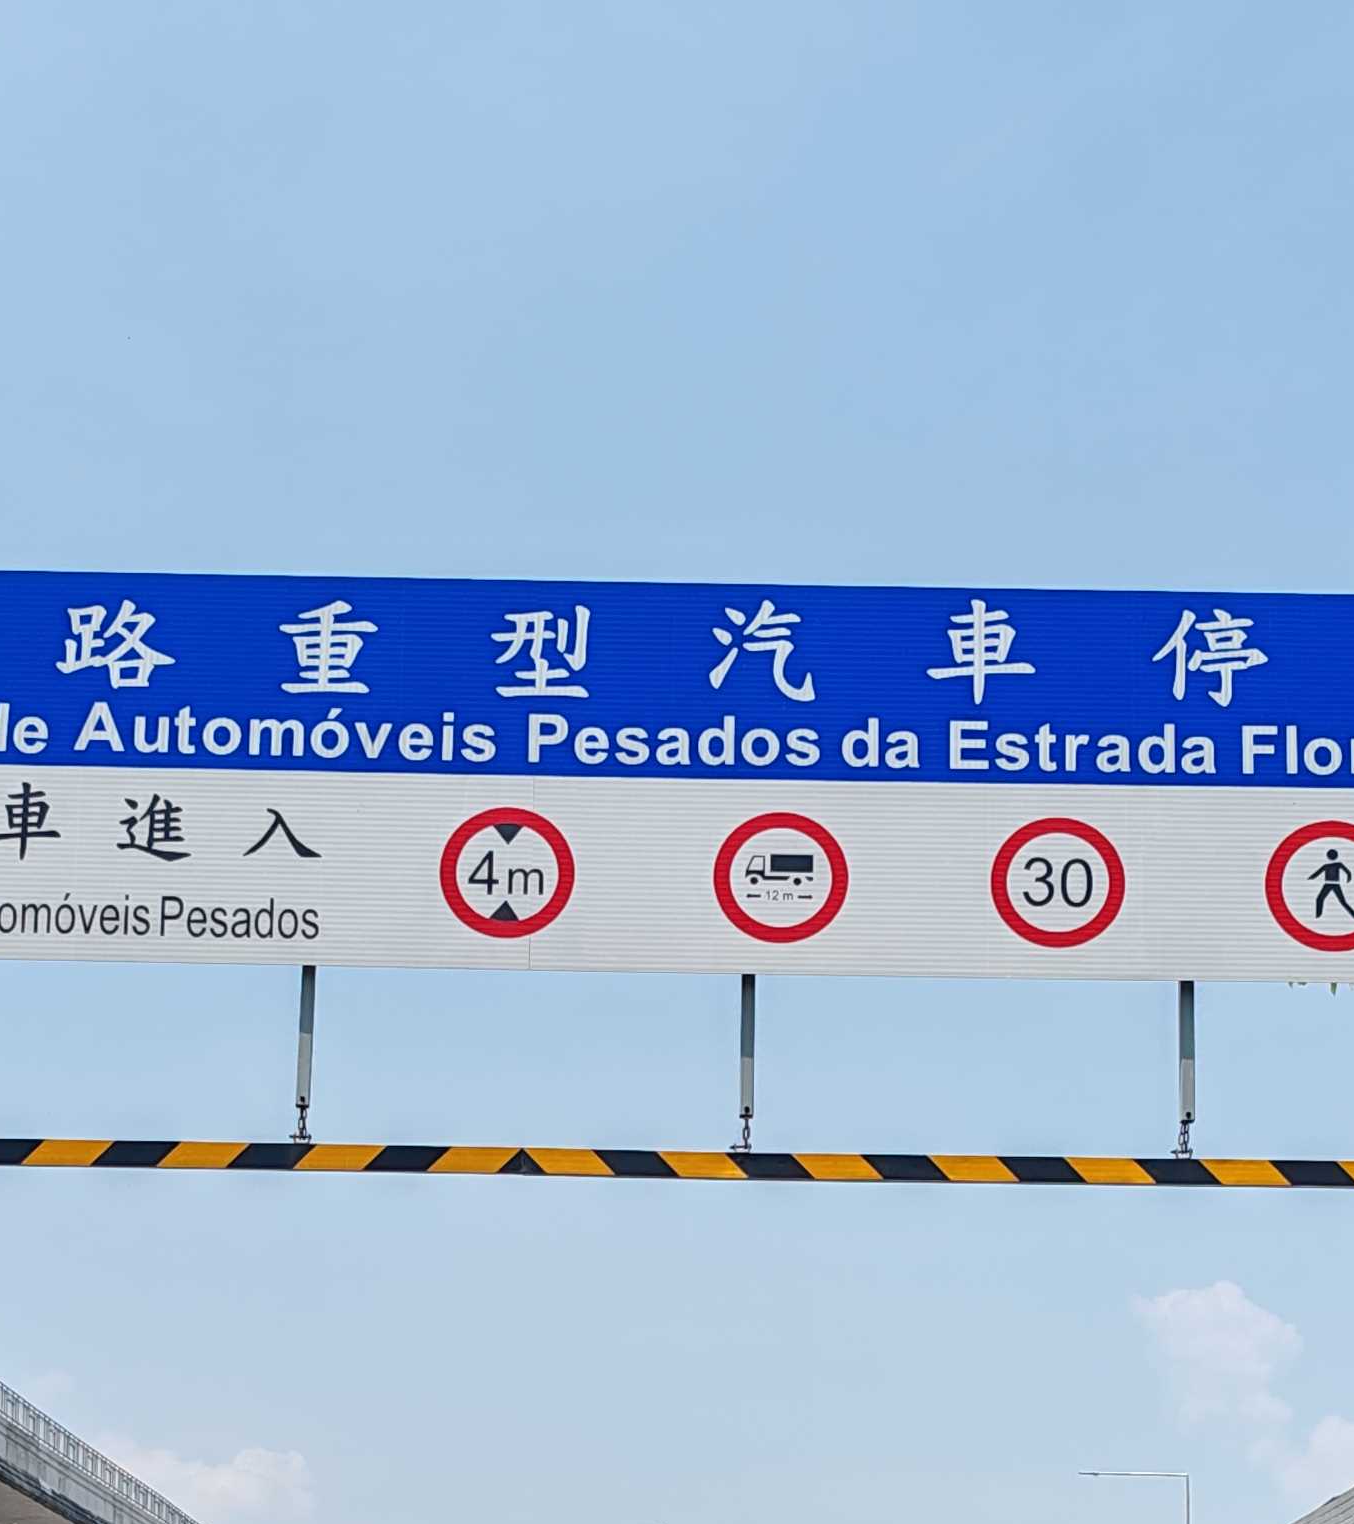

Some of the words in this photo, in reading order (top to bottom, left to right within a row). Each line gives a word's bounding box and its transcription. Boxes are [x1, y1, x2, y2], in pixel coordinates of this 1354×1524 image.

[73, 701, 497, 762] Automóveis
[527, 713, 821, 766] Pesados
[841, 717, 920, 768] da
[949, 720, 1216, 774] Estrada
[1022, 857, 1093, 907] 30
[159, 895, 321, 939] Pesados
